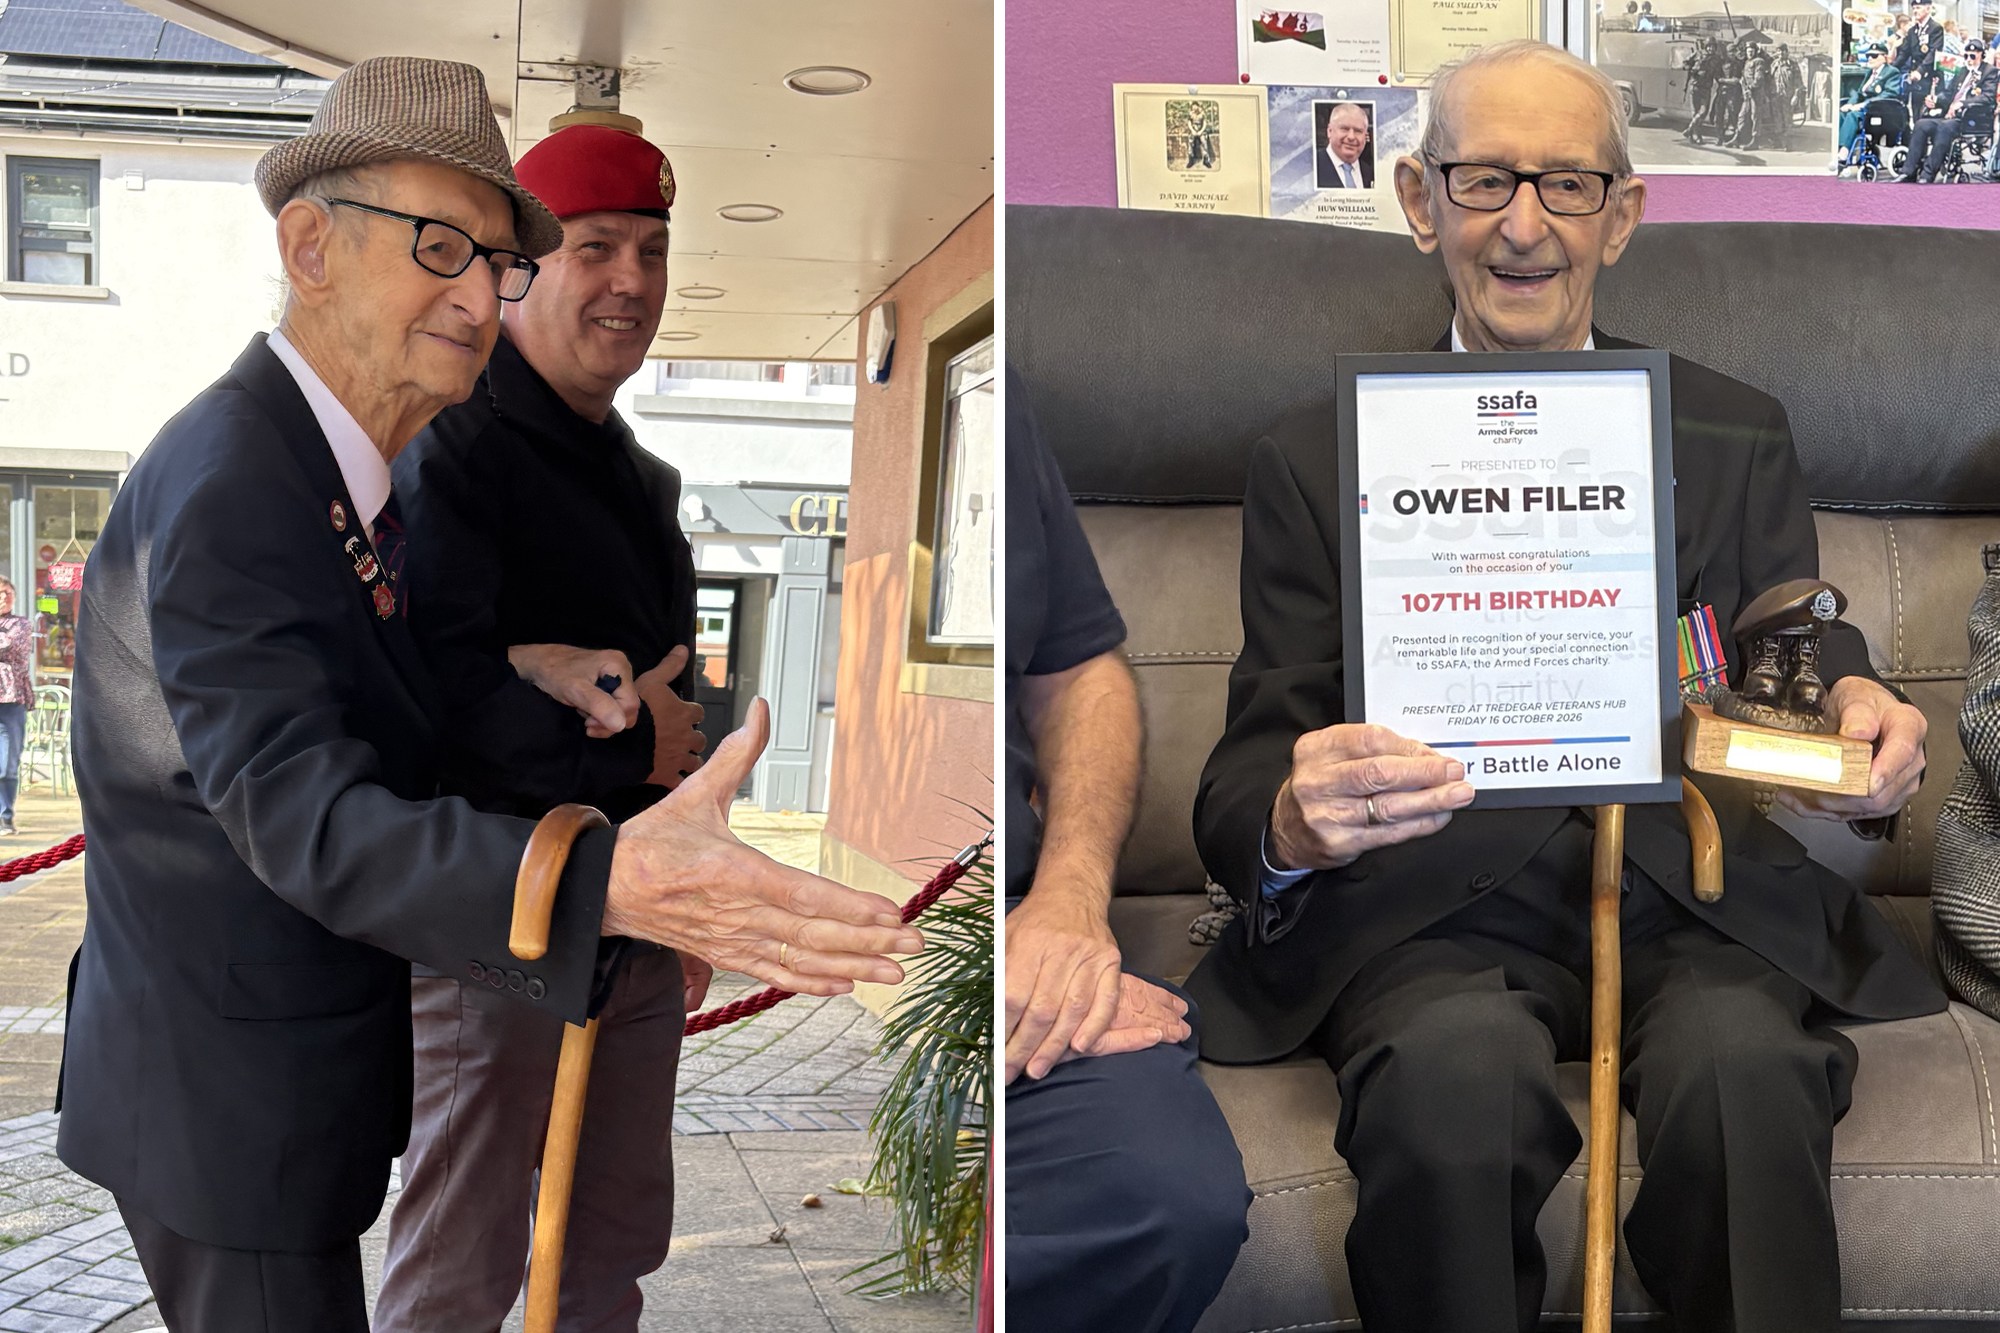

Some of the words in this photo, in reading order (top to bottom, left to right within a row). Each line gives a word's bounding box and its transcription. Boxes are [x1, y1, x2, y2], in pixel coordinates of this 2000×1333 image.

[1192, 193, 1229, 201] MICHAEL
[1477, 390, 1538, 410] ssafa
[1478, 428, 1507, 436] Armed
[1509, 427, 1538, 435] Forces
[1493, 437, 1523, 445] charity
[1461, 459, 1537, 471] PRESENTED
[1539, 458, 1556, 470] TO
[1392, 487, 1510, 515] OWEN
[1522, 485, 1626, 512] FILER
[1431, 551, 1457, 561] With
[1460, 551, 1507, 561] warmest
[1509, 548, 1591, 561] congratulations
[1449, 565, 1463, 574] on
[1466, 564, 1483, 573] the
[1486, 562, 1533, 573] occasion
[1536, 562, 1547, 572] of
[1549, 562, 1573, 574] your
[1401, 592, 1481, 613] 107TH
[1489, 588, 1622, 610] BIRTHDAY
[1392, 635, 1446, 645] Presented
[1449, 634, 1459, 643] in
[1462, 632, 1522, 644] recognition
[1525, 631, 1537, 641] of
[1540, 632, 1563, 642] your
[1566, 630, 1606, 640] service,
[1609, 631, 1633, 641] your
[1397, 647, 1458, 658] remarkable
[1460, 646, 1477, 656] life
[1479, 646, 1500, 655] and
[1502, 646, 1527, 656] your
[1529, 643, 1567, 655] special
[1569, 642, 1629, 653] connection
[1416, 661, 1428, 670] to
[1431, 660, 1471, 670] SSAFA,
[1473, 659, 1491, 668] the
[1493, 657, 1531, 668] Armed
[1534, 657, 1569, 667] Forces
[1571, 656, 1610, 667] charity.
[1402, 704, 1466, 715] PRESENTED
[1468, 703, 1483, 713] AT
[1485, 702, 1542, 712] TREDEGAR
[1545, 700, 1601, 710] VETERANS
[1603, 699, 1627, 709] HUB
[1447, 716, 1487, 726] FRIDAY
[1489, 715, 1500, 724] 16
[1502, 714, 1554, 724] OCTOBER
[1556, 713, 1583, 722] 2026
[1483, 755, 1549, 774] Battle
[1557, 753, 1622, 771] Alone
